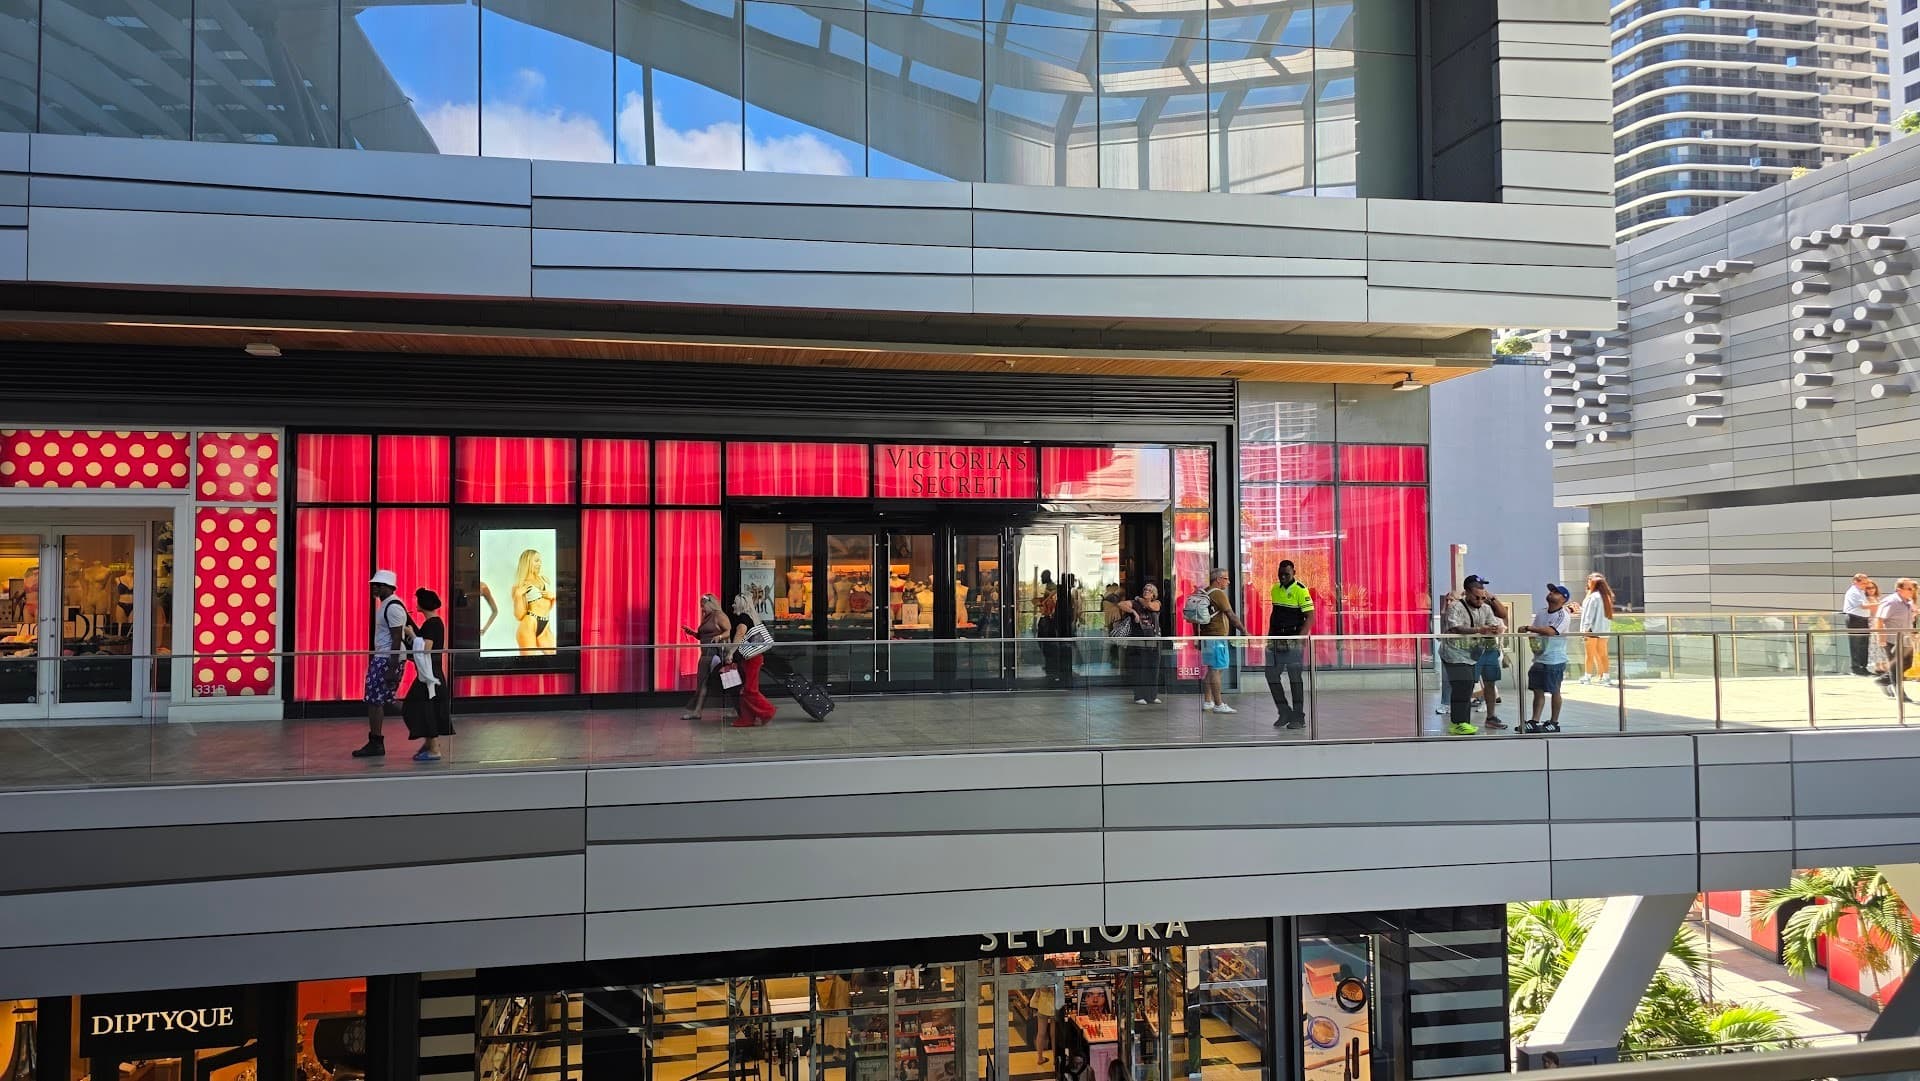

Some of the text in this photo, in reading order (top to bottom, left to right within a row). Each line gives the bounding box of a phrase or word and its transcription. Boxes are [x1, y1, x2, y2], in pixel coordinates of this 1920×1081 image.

[887, 448, 1026, 470] VICTORIA'S
[911, 473, 1002, 494] SECRET
[1178, 667, 1201, 676] 331B
[195, 684, 226, 695] 331B
[980, 920, 1190, 951] SEPHORA
[90, 1006, 234, 1036] DIPTYQUE
